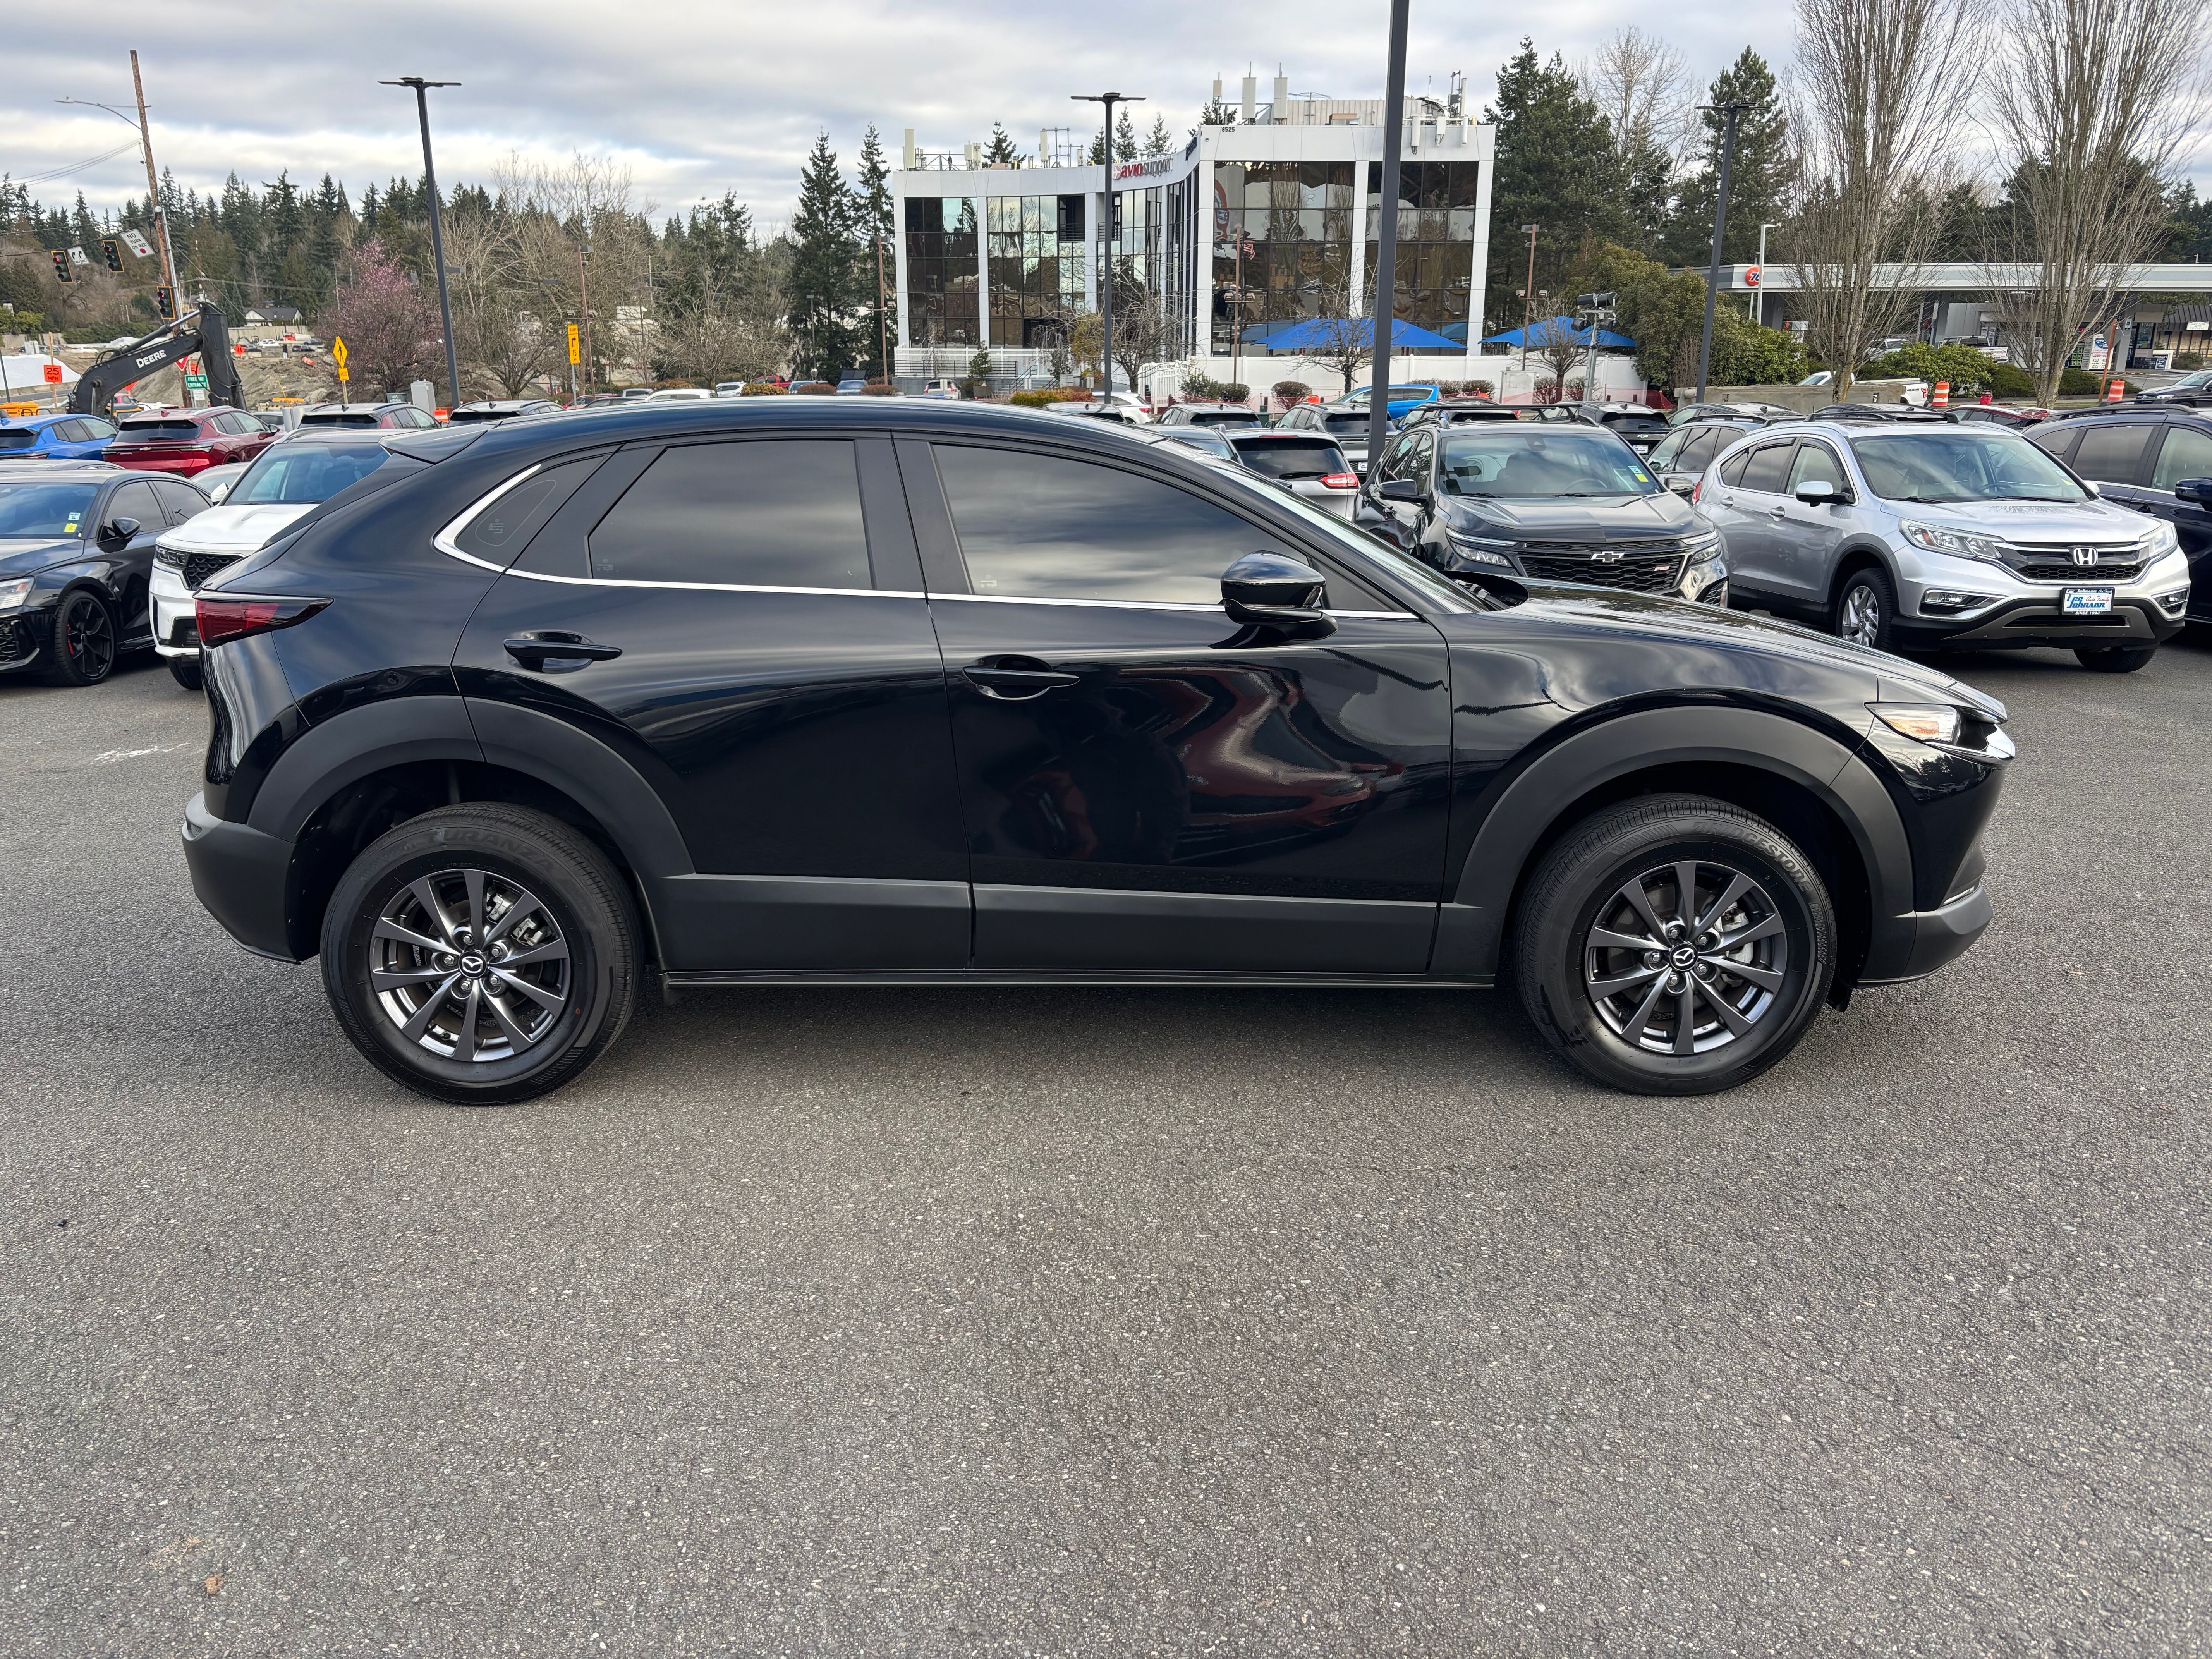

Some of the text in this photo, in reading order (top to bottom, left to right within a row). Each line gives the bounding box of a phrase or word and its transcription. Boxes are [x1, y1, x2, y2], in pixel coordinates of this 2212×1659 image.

[136, 349, 167, 368] DEERE
[427, 829, 554, 871] TURANZA
[1691, 821, 1813, 892] BRIDGESTONE
